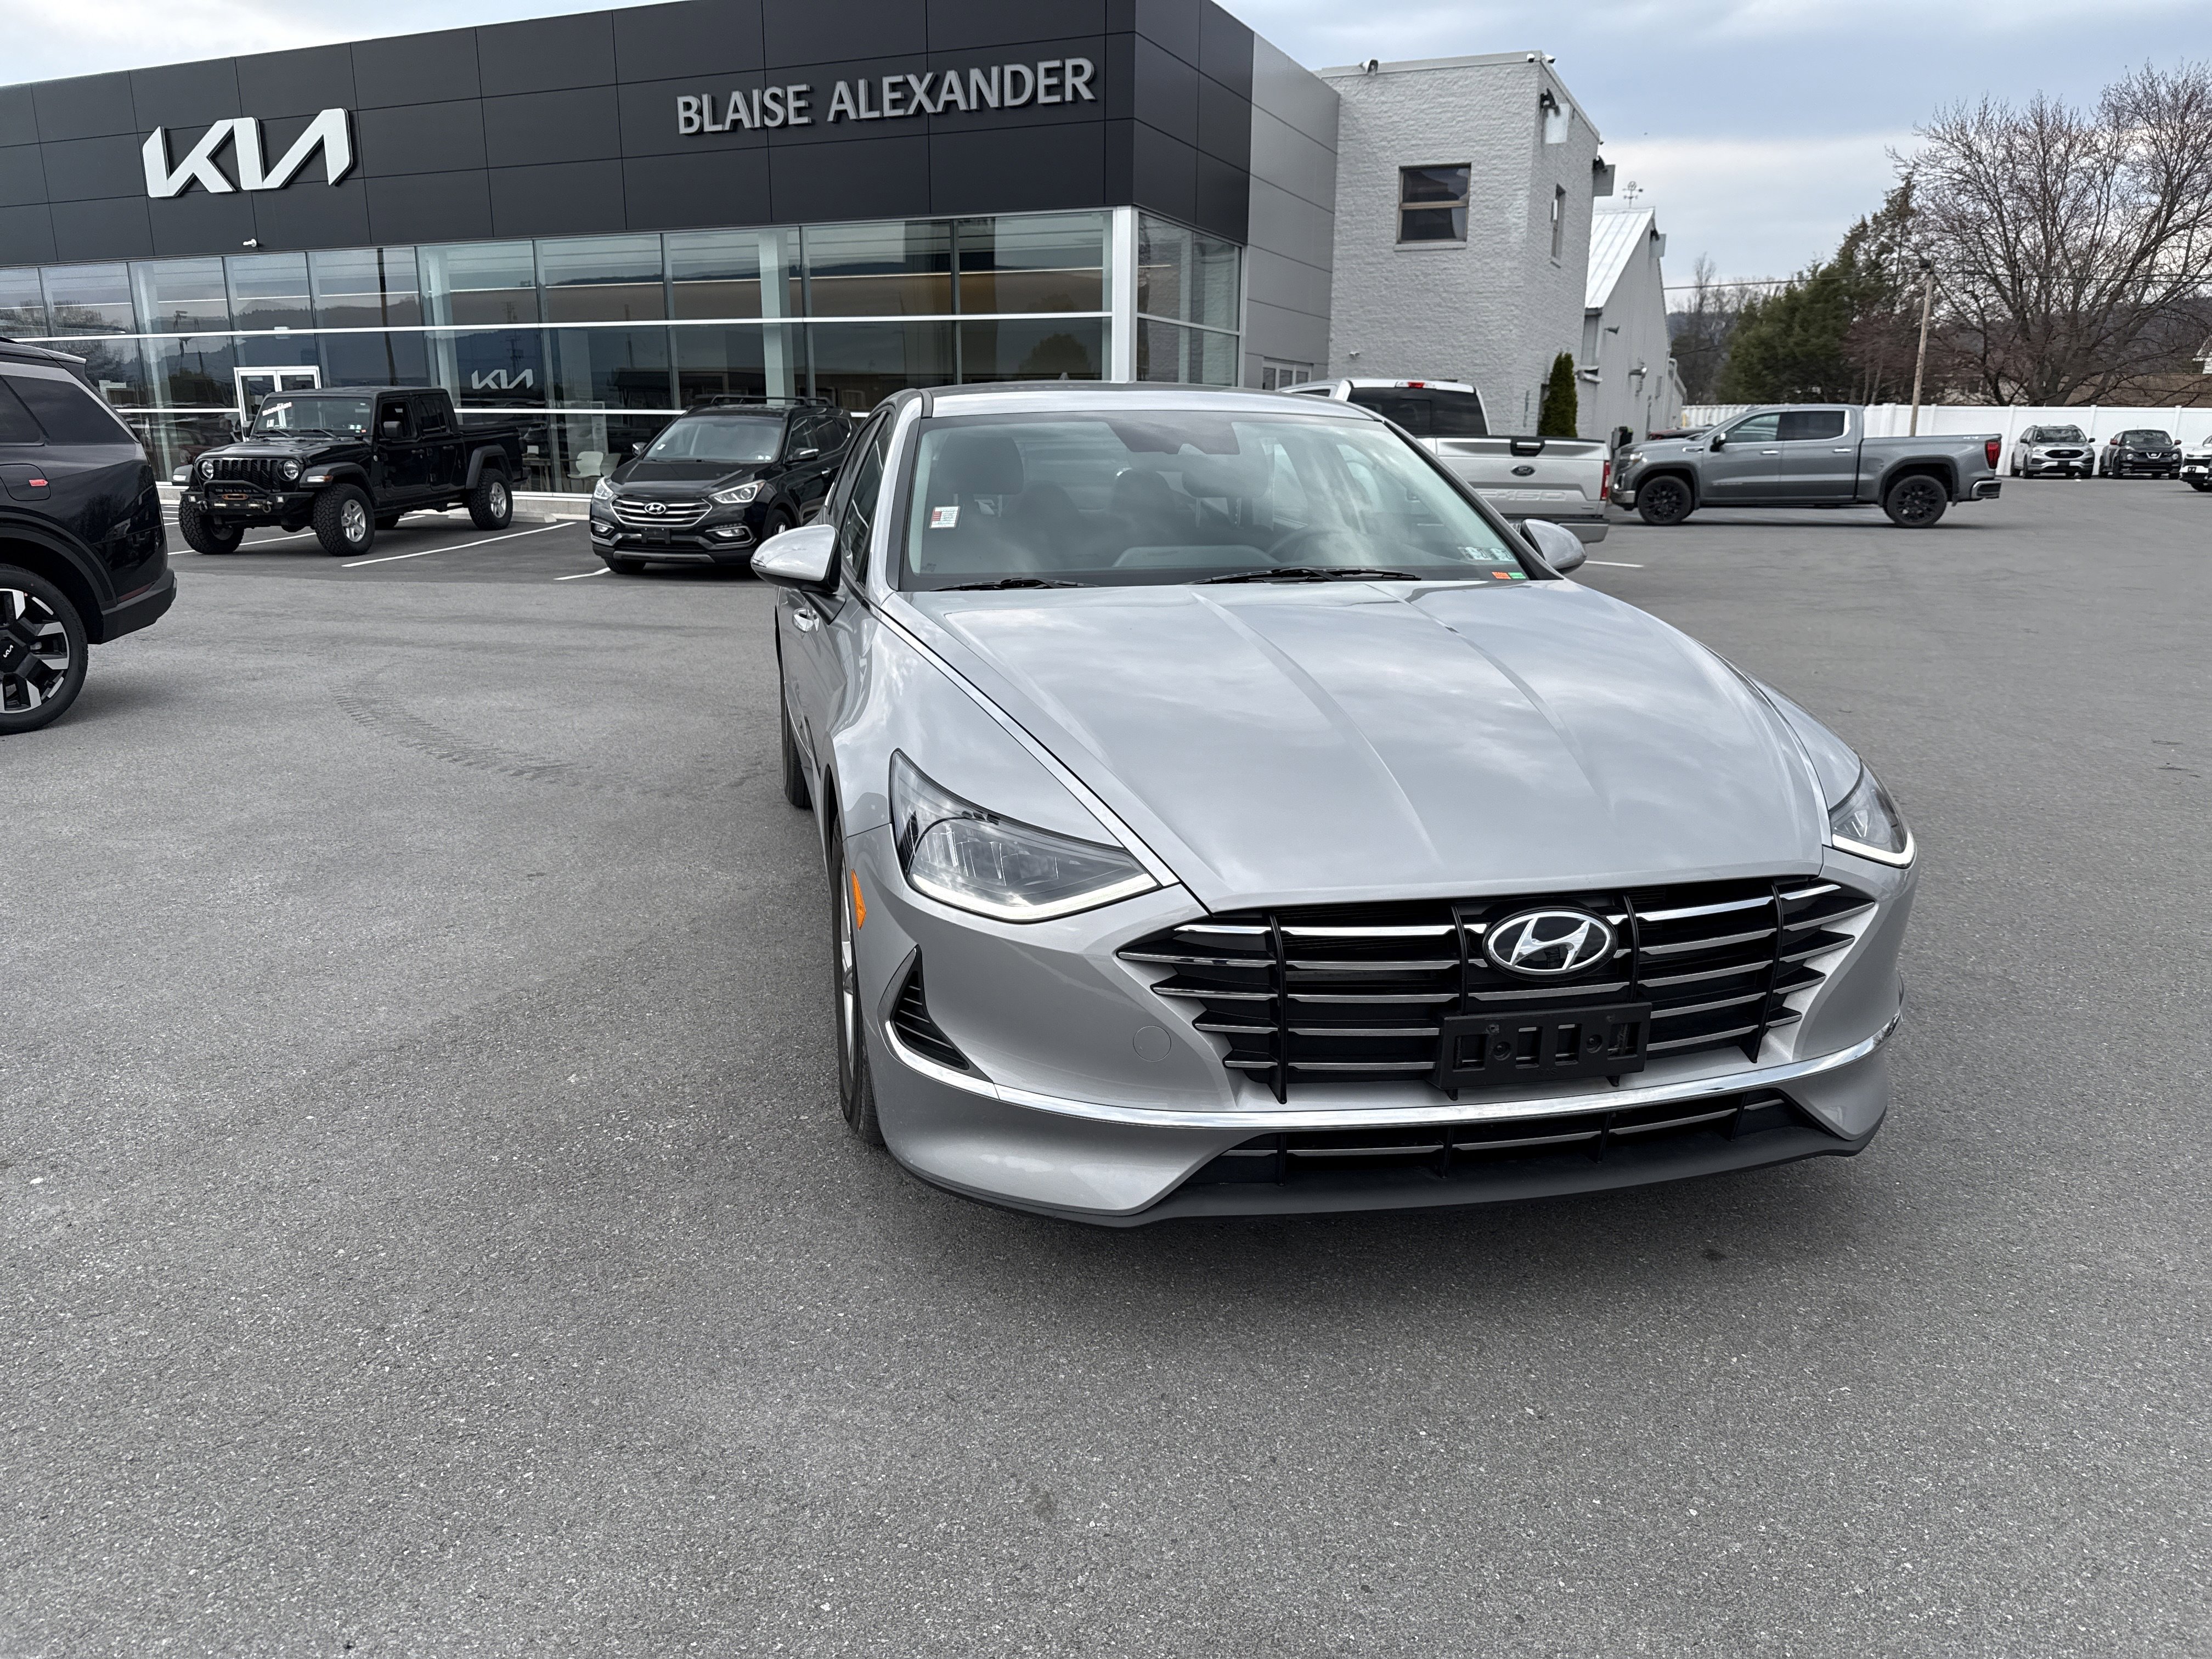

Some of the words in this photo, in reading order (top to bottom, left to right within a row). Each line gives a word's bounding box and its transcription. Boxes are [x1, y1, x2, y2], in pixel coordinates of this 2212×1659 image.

[676, 84, 812, 134] BLAISE
[827, 57, 1096, 123] ALEXANDER
[143, 108, 353, 198] KIA
[471, 369, 533, 389] KIA
